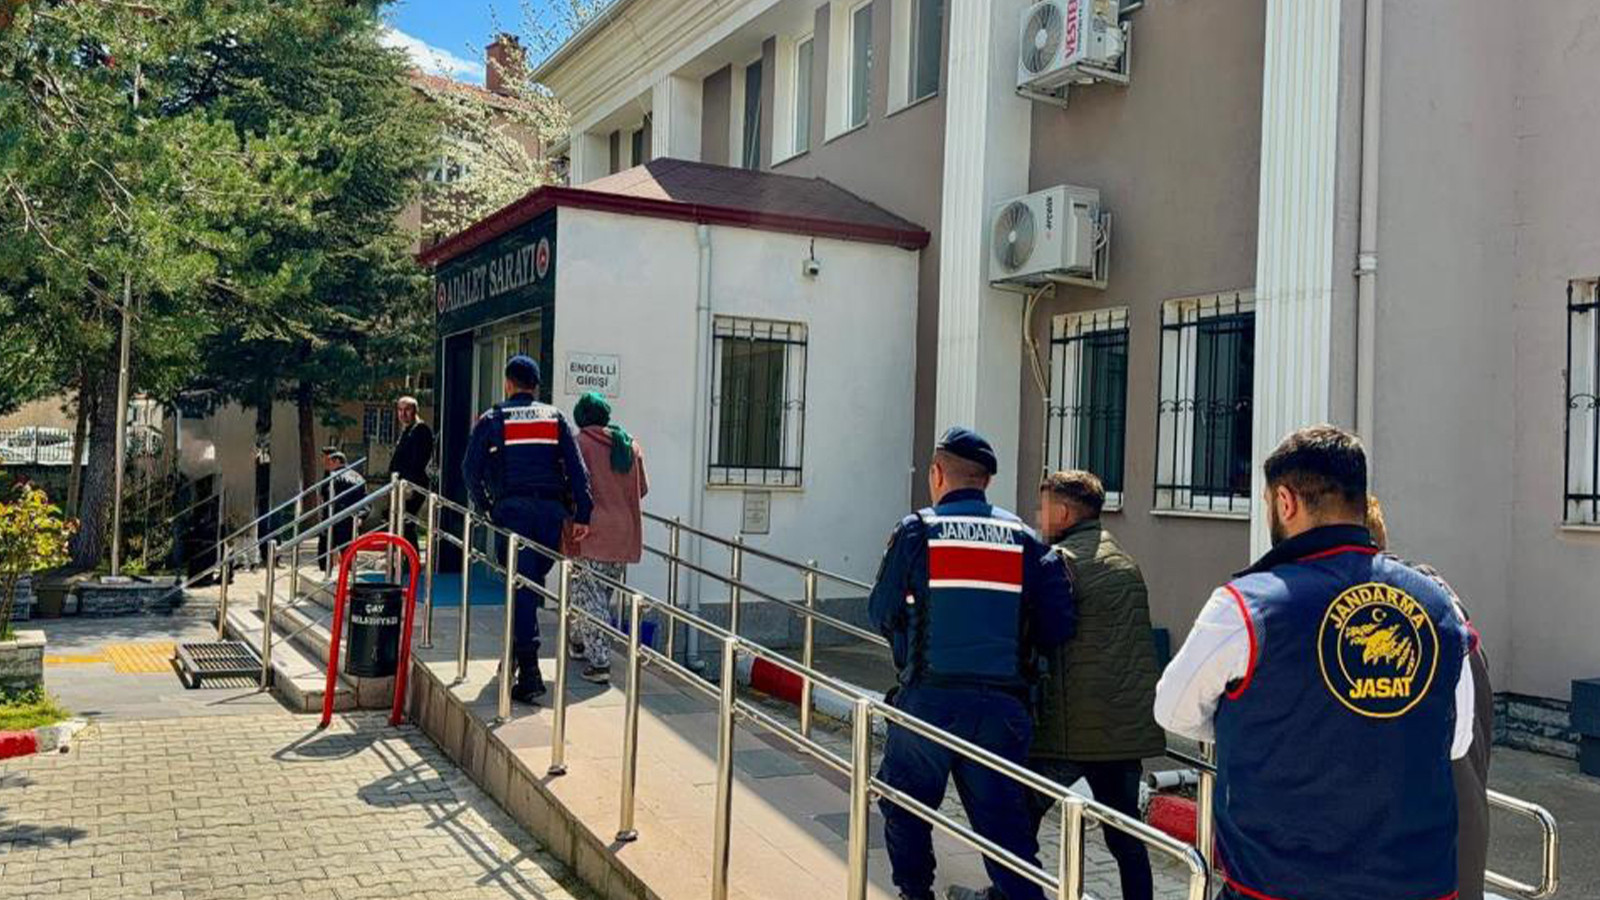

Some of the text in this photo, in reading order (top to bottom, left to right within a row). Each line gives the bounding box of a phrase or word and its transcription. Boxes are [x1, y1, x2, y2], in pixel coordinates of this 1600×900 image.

[445, 243, 536, 312] ADALET SARAYI
[570, 361, 616, 376] ENGELLİ
[938, 521, 1015, 544] JANDARMA
[1330, 586, 1426, 630] JANDARMA
[1350, 676, 1412, 699] JASAT
